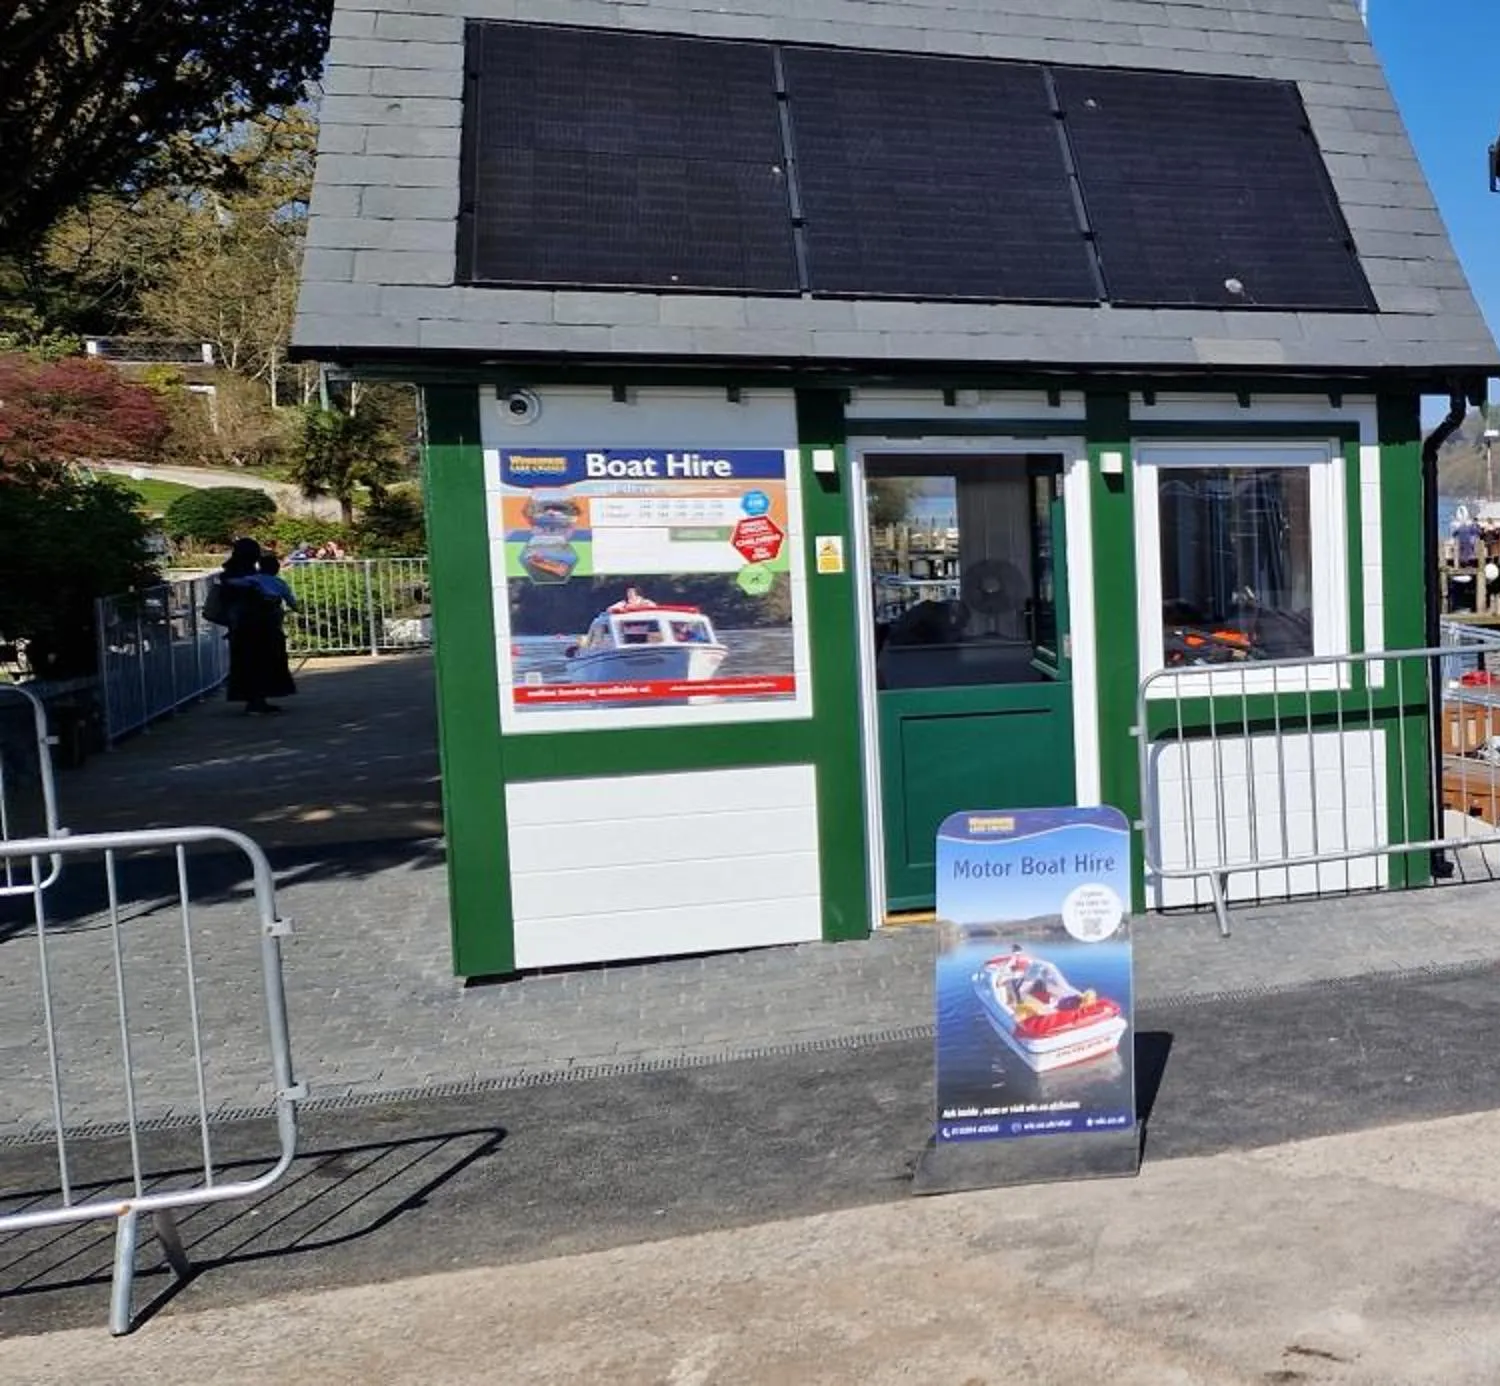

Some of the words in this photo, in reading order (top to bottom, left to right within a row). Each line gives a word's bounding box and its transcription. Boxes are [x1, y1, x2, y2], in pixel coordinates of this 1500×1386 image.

[586, 453, 658, 477] Boat
[666, 453, 733, 477] Hire
[954, 859, 1012, 880] Motor
[1021, 855, 1066, 875] Boat
[1075, 853, 1117, 873] Hire
